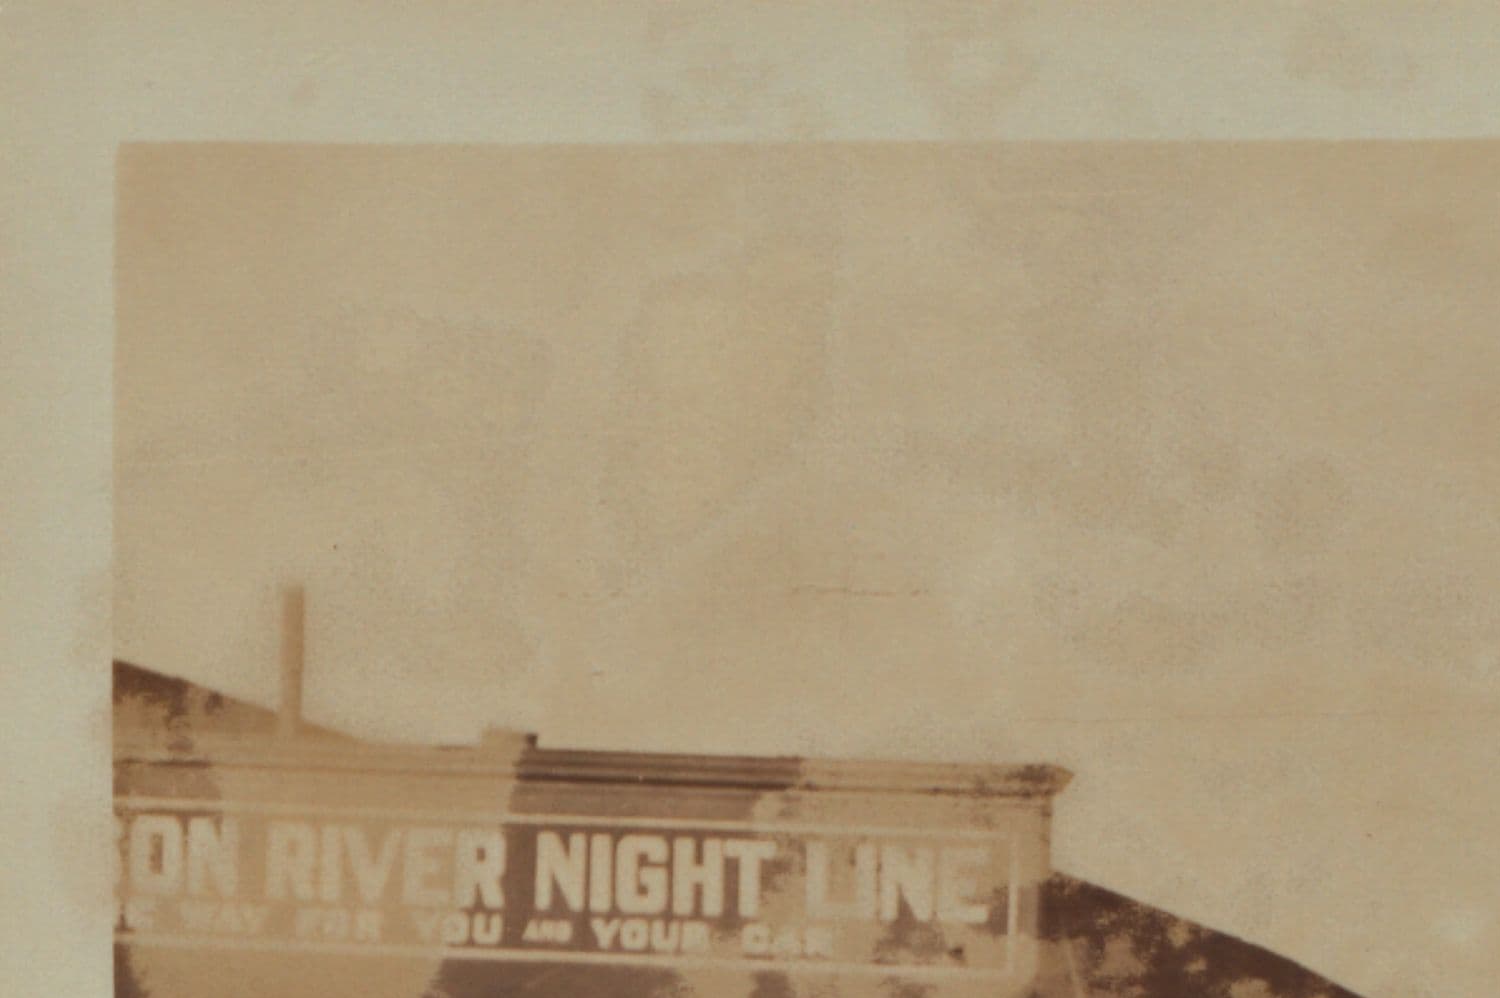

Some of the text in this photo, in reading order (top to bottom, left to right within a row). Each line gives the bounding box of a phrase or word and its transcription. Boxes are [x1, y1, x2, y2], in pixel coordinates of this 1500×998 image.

[113, 815, 993, 924] ON RIVER NIGHT LINE
[414, 911, 502, 945] YOU
[521, 918, 574, 945] AND
[589, 916, 711, 953] YOUR
[740, 922, 834, 957] CAR
